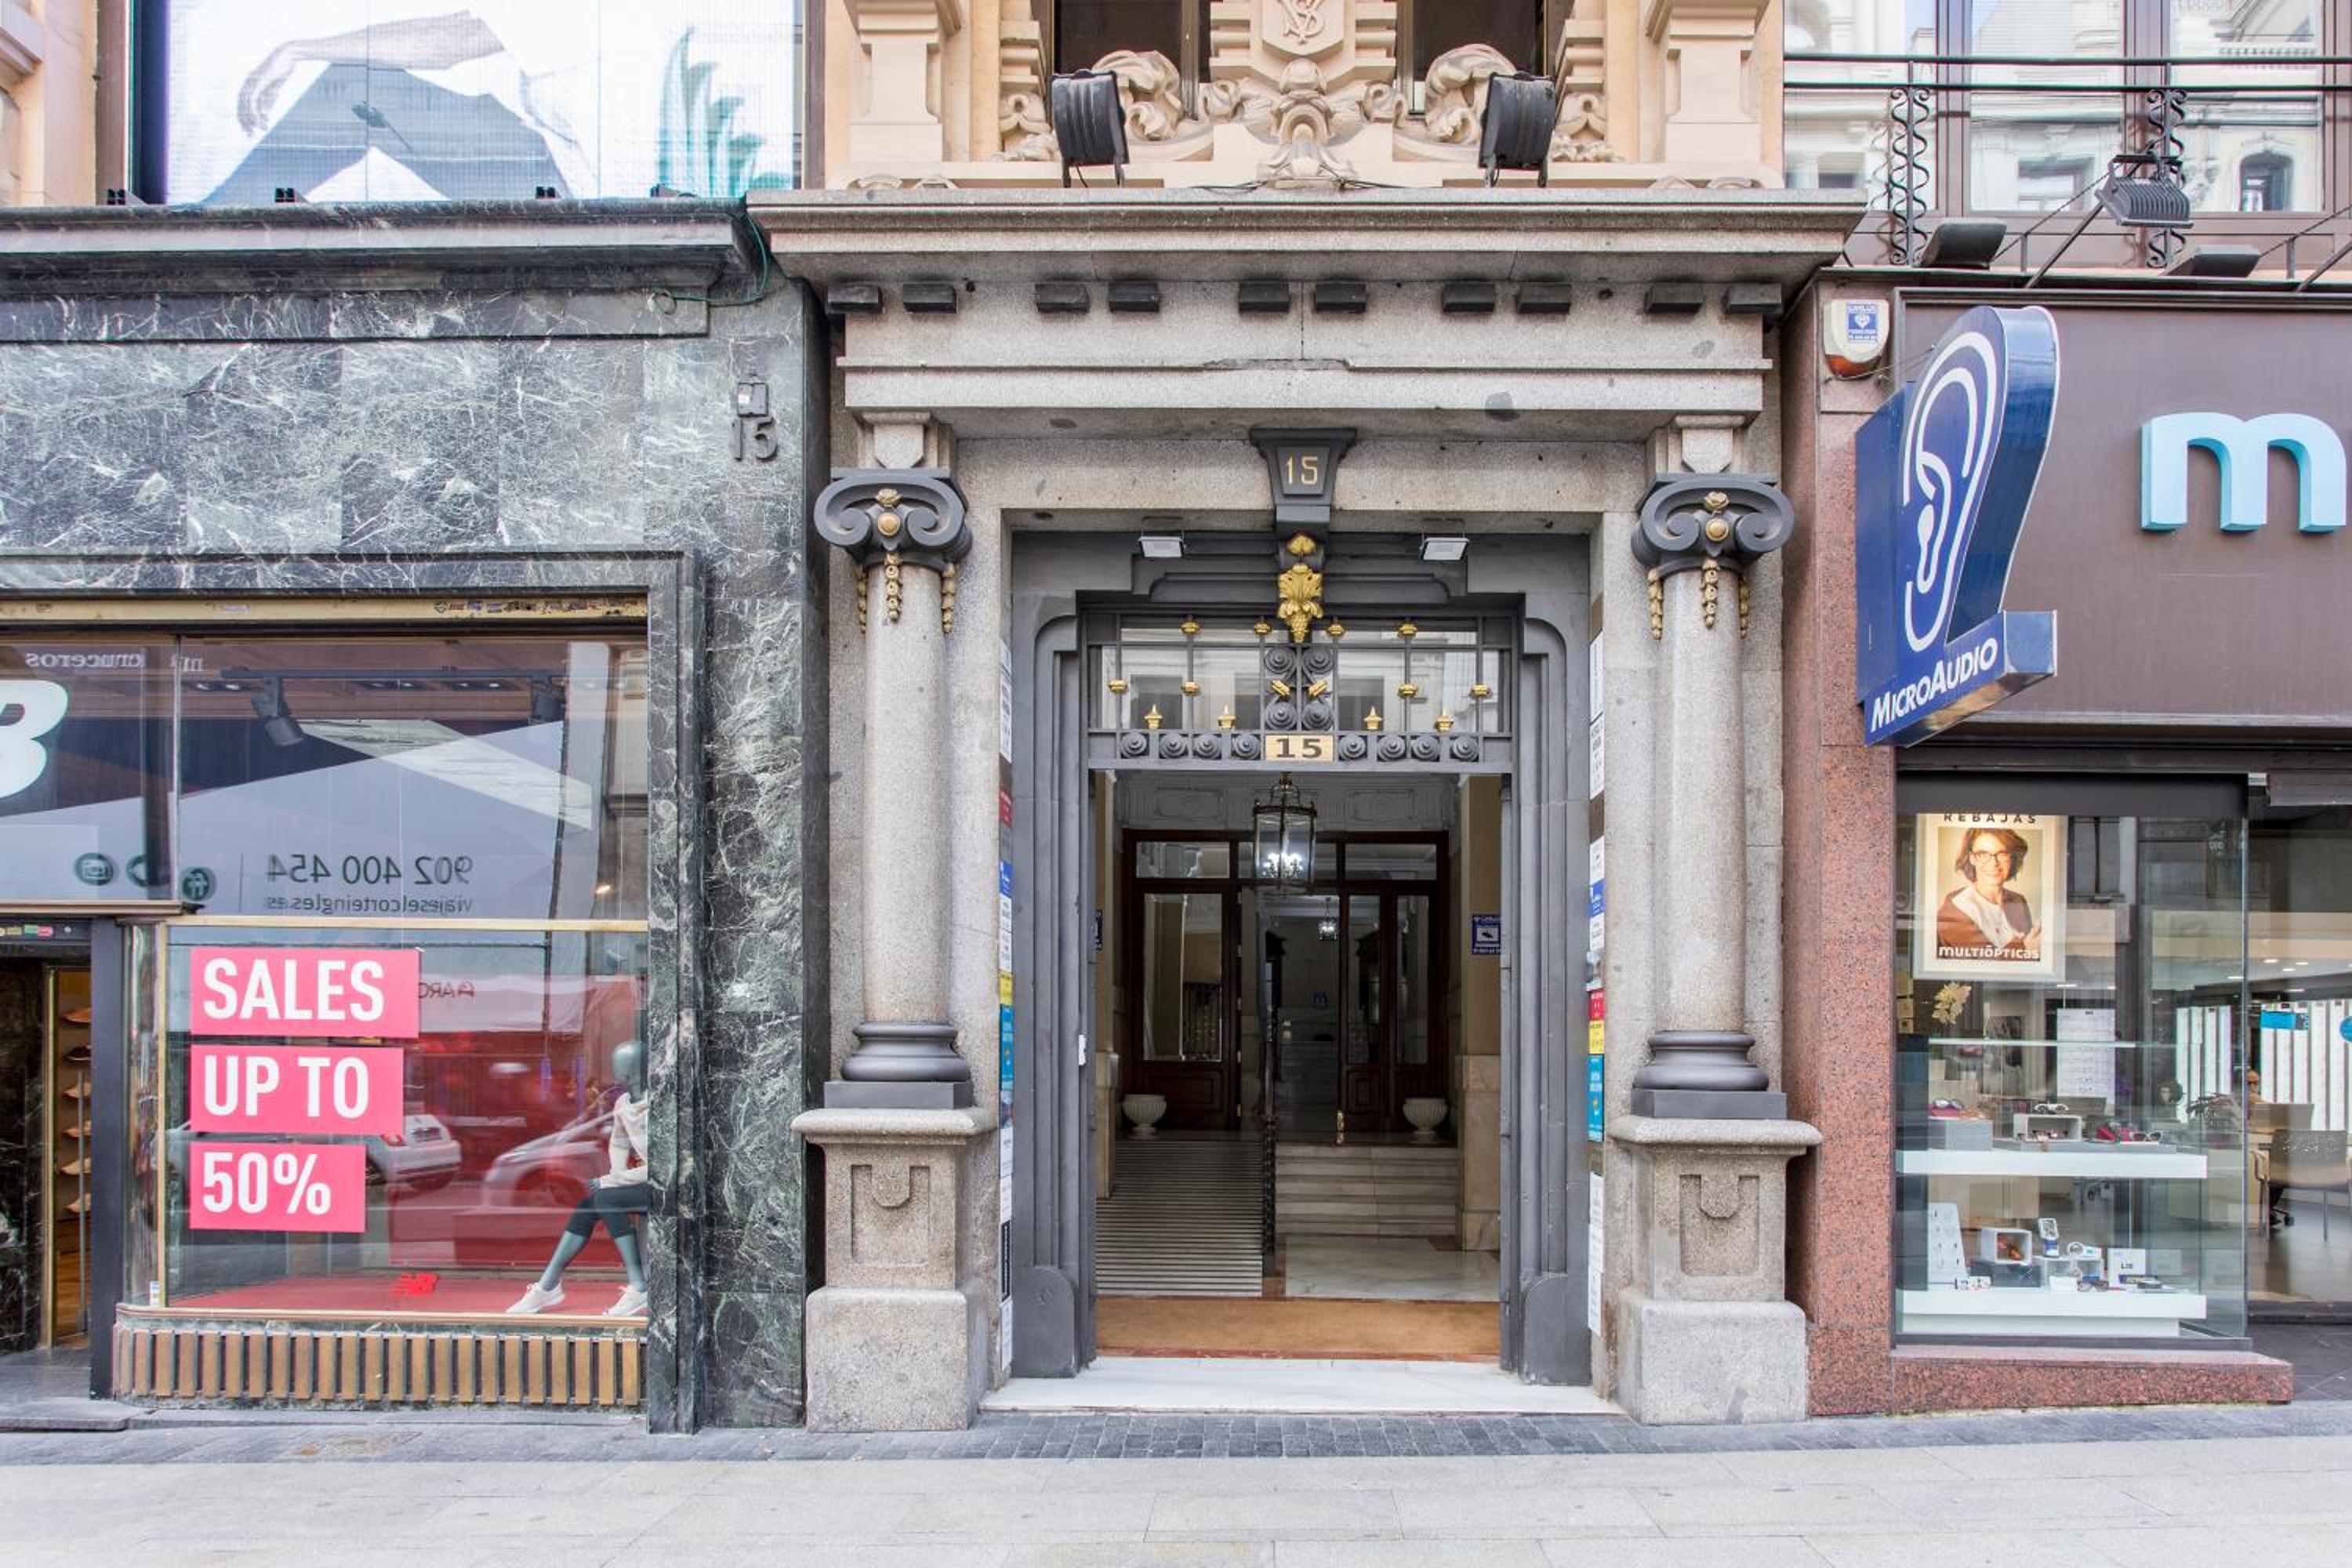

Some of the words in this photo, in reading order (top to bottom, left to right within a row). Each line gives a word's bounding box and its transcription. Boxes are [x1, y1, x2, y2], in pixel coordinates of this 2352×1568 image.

[731, 416, 779, 462] 15
[1286, 456, 1318, 485] 15
[2141, 412, 2347, 532] m
[1276, 738, 1323, 758] 15
[1944, 812, 2036, 823] REBAJAS
[203, 957, 384, 1022] SALES
[204, 1054, 281, 1116] UP
[297, 1056, 369, 1119] TO
[202, 1152, 332, 1215] 50%
